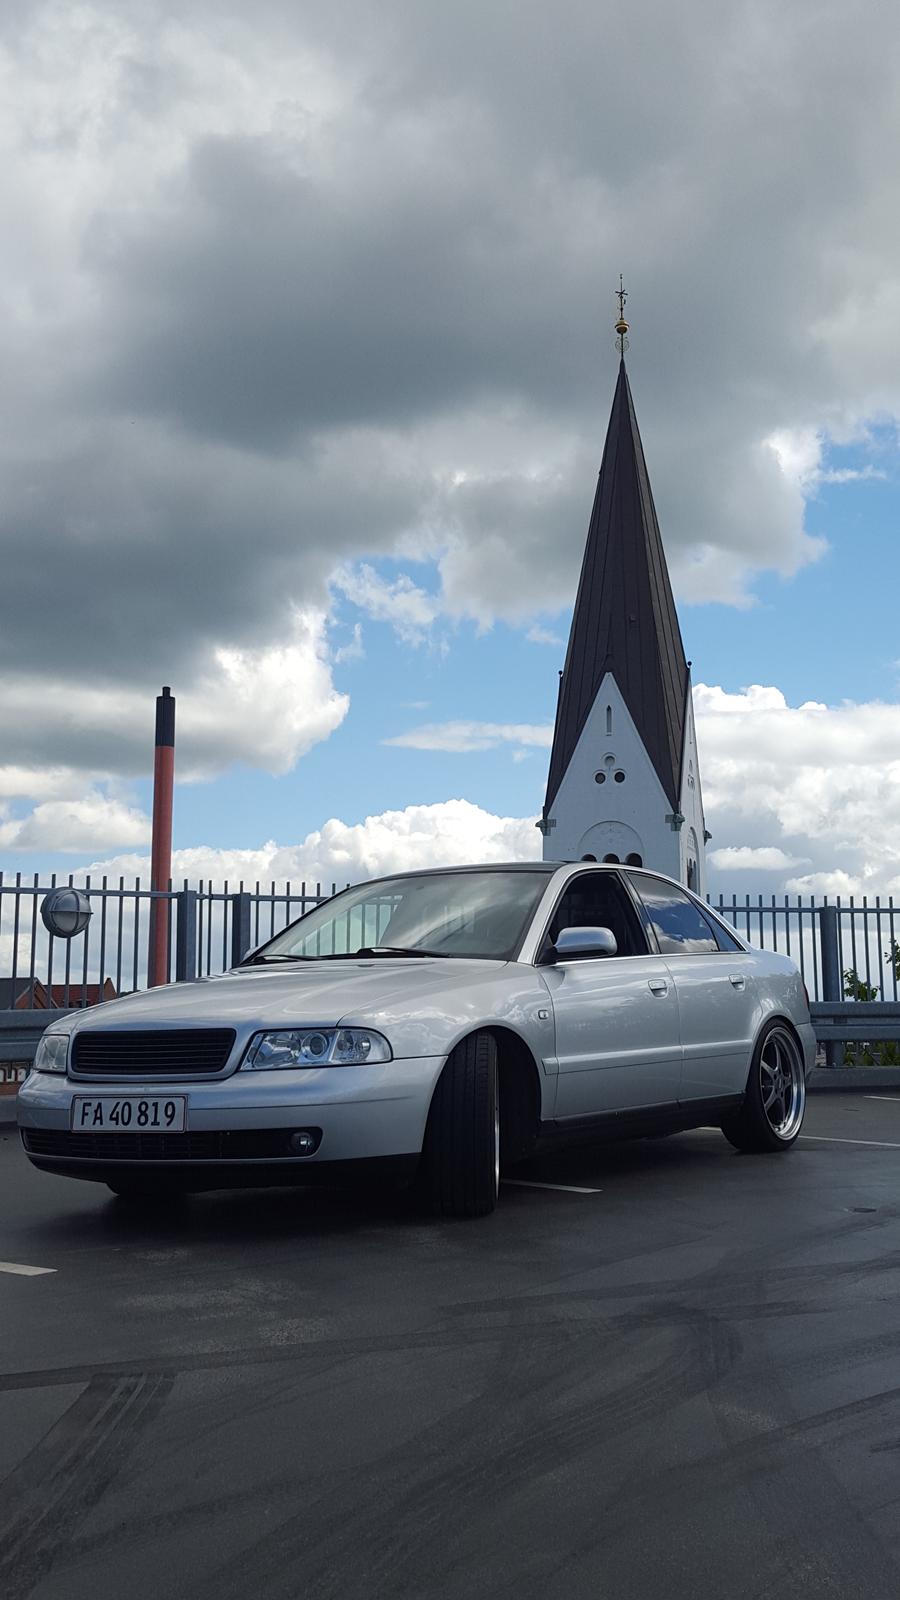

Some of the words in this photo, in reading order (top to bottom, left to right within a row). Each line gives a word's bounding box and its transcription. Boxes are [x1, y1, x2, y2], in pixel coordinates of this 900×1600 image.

[80, 1101, 104, 1126] FA
[108, 1101, 132, 1126] 40
[136, 1100, 176, 1127] 819
